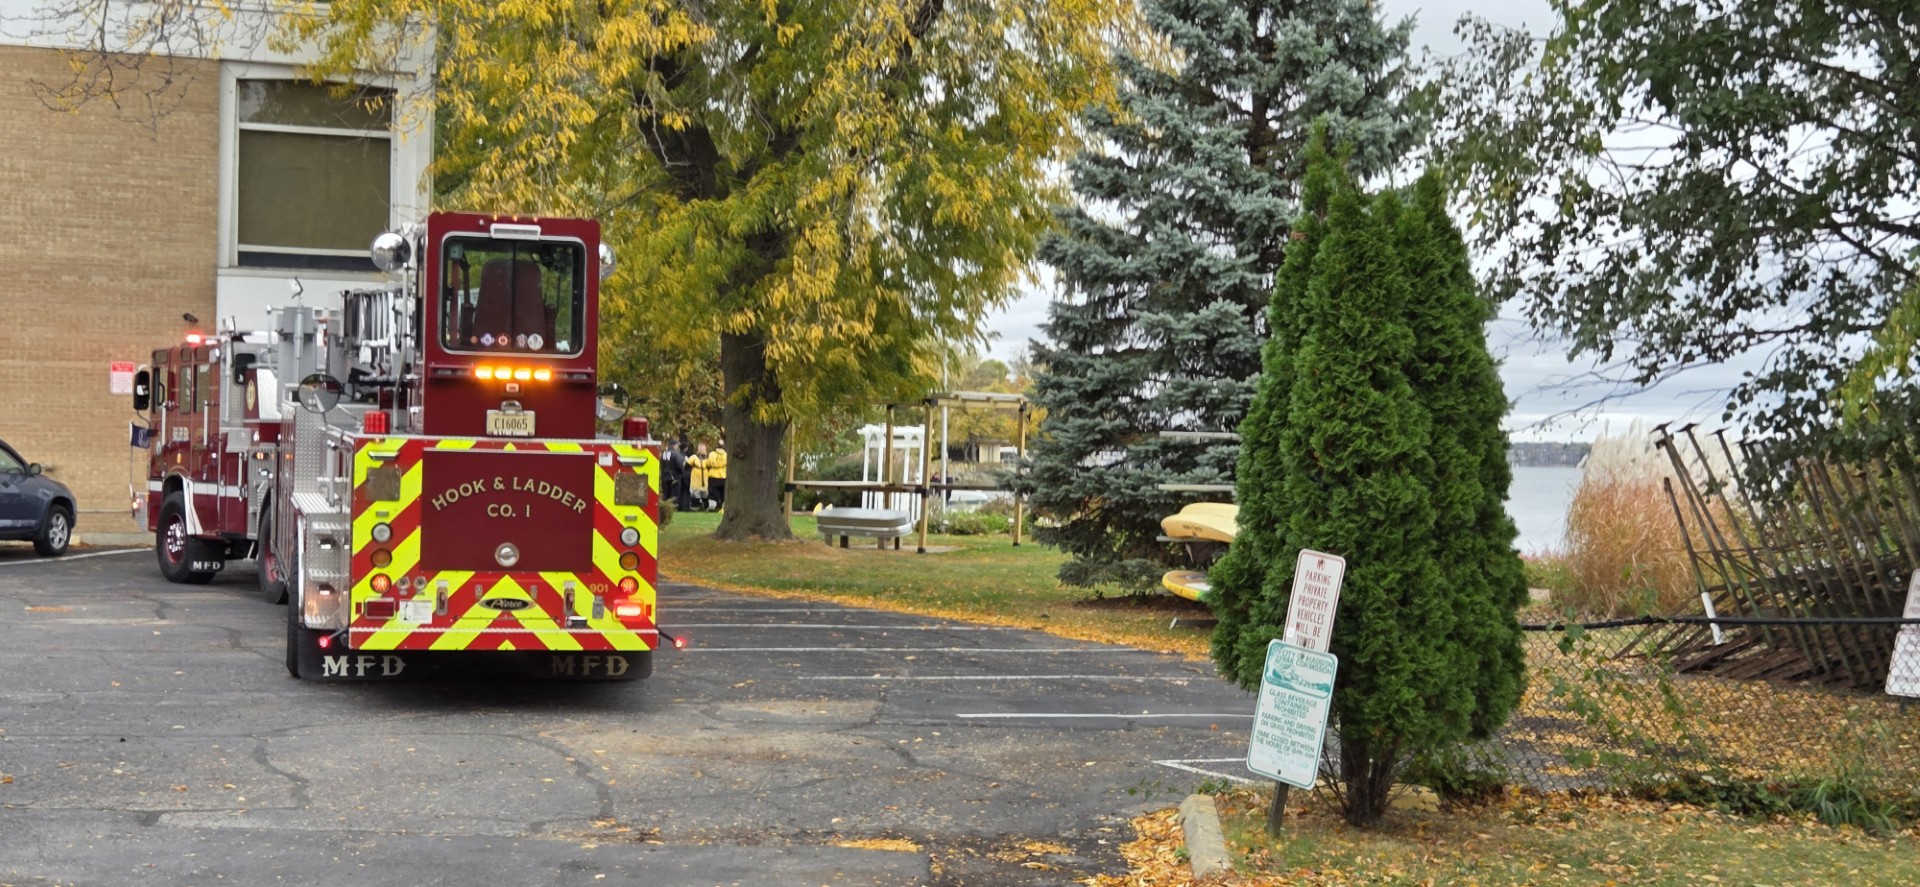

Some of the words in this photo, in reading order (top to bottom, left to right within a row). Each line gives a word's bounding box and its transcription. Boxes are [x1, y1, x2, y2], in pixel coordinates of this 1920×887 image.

[494, 418, 528, 430] C16065
[432, 479, 486, 511] HOOK
[493, 476, 505, 490] &
[513, 477, 586, 514] LADDER
[487, 504, 516, 517] CO.
[192, 561, 220, 570] MFD
[1316, 560, 1326, 570] NO
[1305, 570, 1332, 586] PARKING
[590, 584, 608, 592] 901
[1303, 583, 1328, 598] PRIVATE
[490, 598, 522, 608] Pierce
[1298, 595, 1328, 612] PROPERTY
[1297, 608, 1325, 625] VEHICLES
[1296, 622, 1308, 635] WILL
[1313, 626, 1321, 638] BE
[1296, 635, 1316, 650] TOWED
[322, 655, 406, 676] MFD
[551, 656, 630, 676] MFD
[1296, 660, 1332, 674] COMMISSION
[1306, 656, 1332, 667] MADISON
[1270, 689, 1287, 700] GLASS
[1288, 694, 1317, 708] BEVERAGE
[1274, 697, 1309, 712] CONTAINERS
[1274, 704, 1306, 718] PROHIBITED
[1262, 712, 1282, 724] PARKING
[1296, 722, 1316, 734] DRIVING
[1270, 722, 1285, 731] GRASS
[1286, 726, 1315, 741] PROHIBITED
[1257, 730, 1269, 738] PARK
[1271, 734, 1289, 745] CLOSED
[1290, 740, 1315, 752] BETWEEN
[1266, 740, 1282, 750] HOURS
